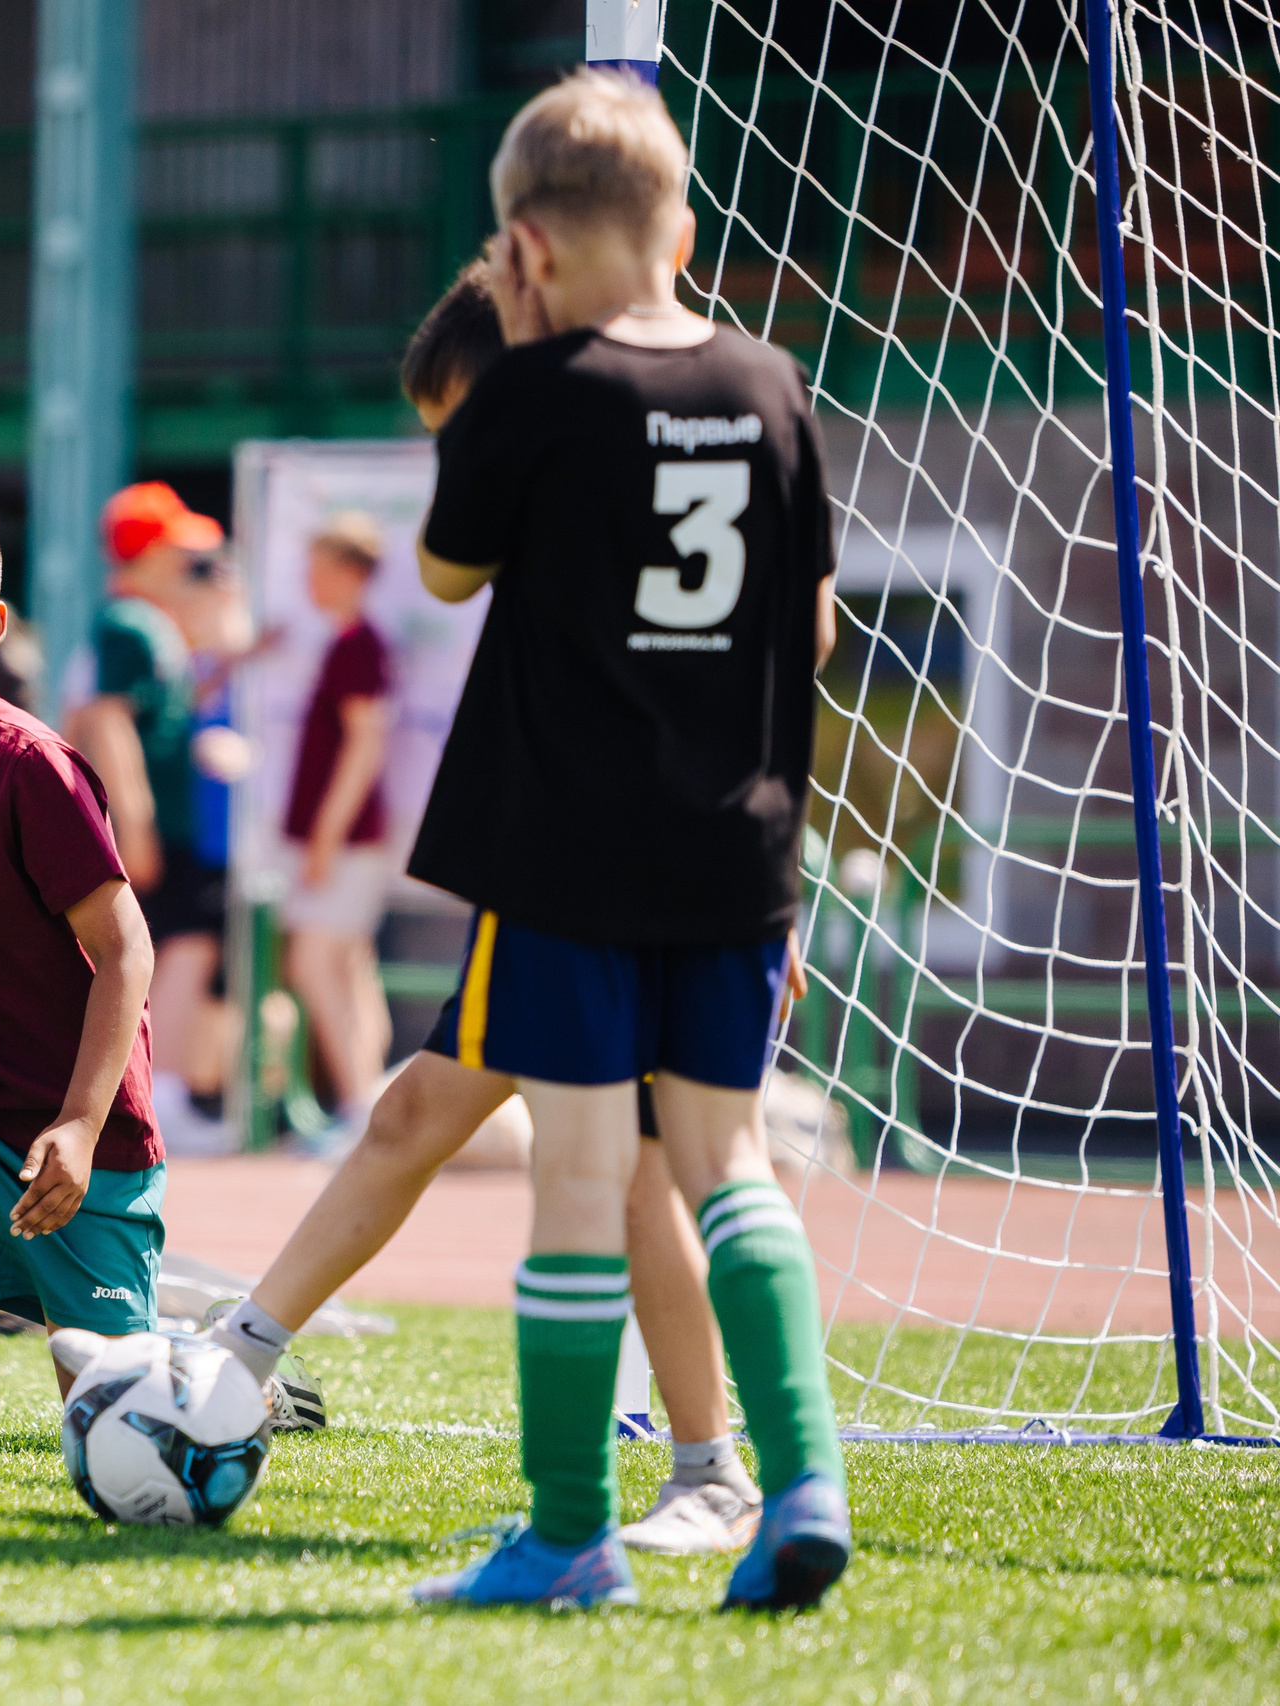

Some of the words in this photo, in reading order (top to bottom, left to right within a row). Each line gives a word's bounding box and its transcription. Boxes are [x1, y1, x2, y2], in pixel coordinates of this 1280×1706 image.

[646, 410, 763, 455] Первые
[634, 460, 751, 629] 3
[92, 1286, 133, 1300] Joma
